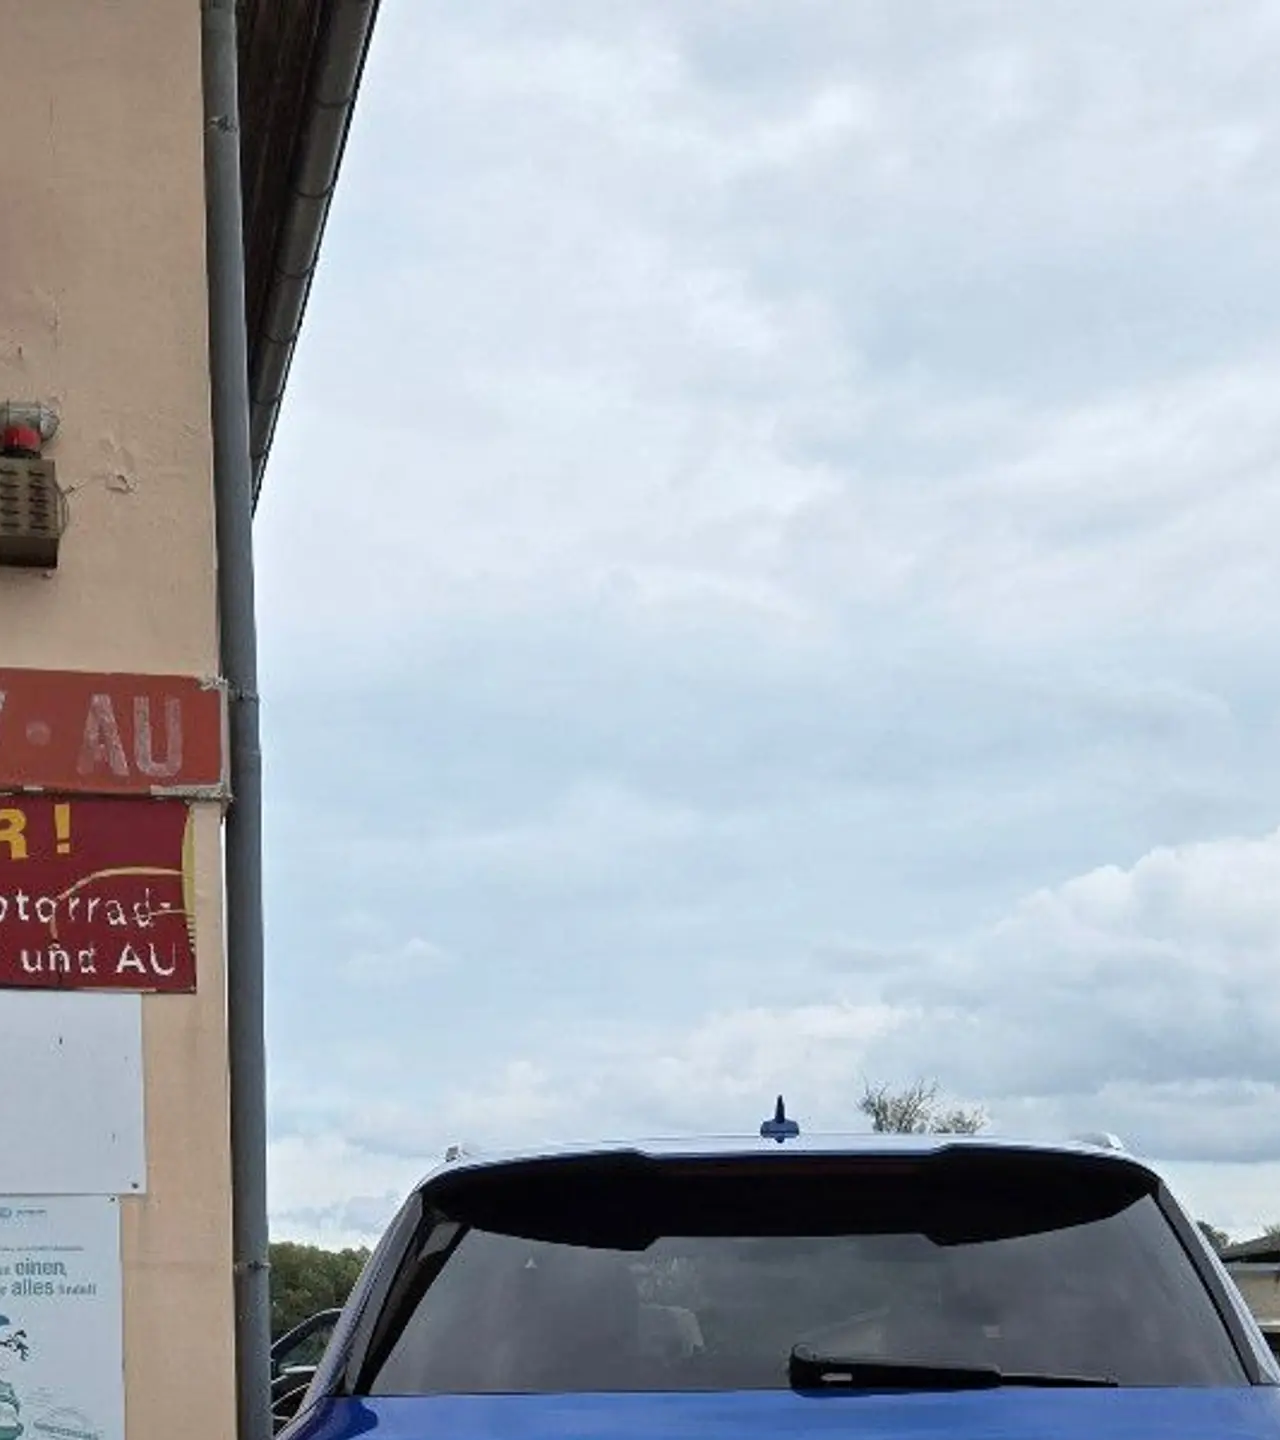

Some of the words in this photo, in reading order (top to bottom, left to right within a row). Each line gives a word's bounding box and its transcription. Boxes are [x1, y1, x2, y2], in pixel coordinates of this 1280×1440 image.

[76, 693, 184, 777] AU
[20, 938, 98, 974] und
[115, 942, 177, 976] AU
[10, 1276, 55, 1297] alles
